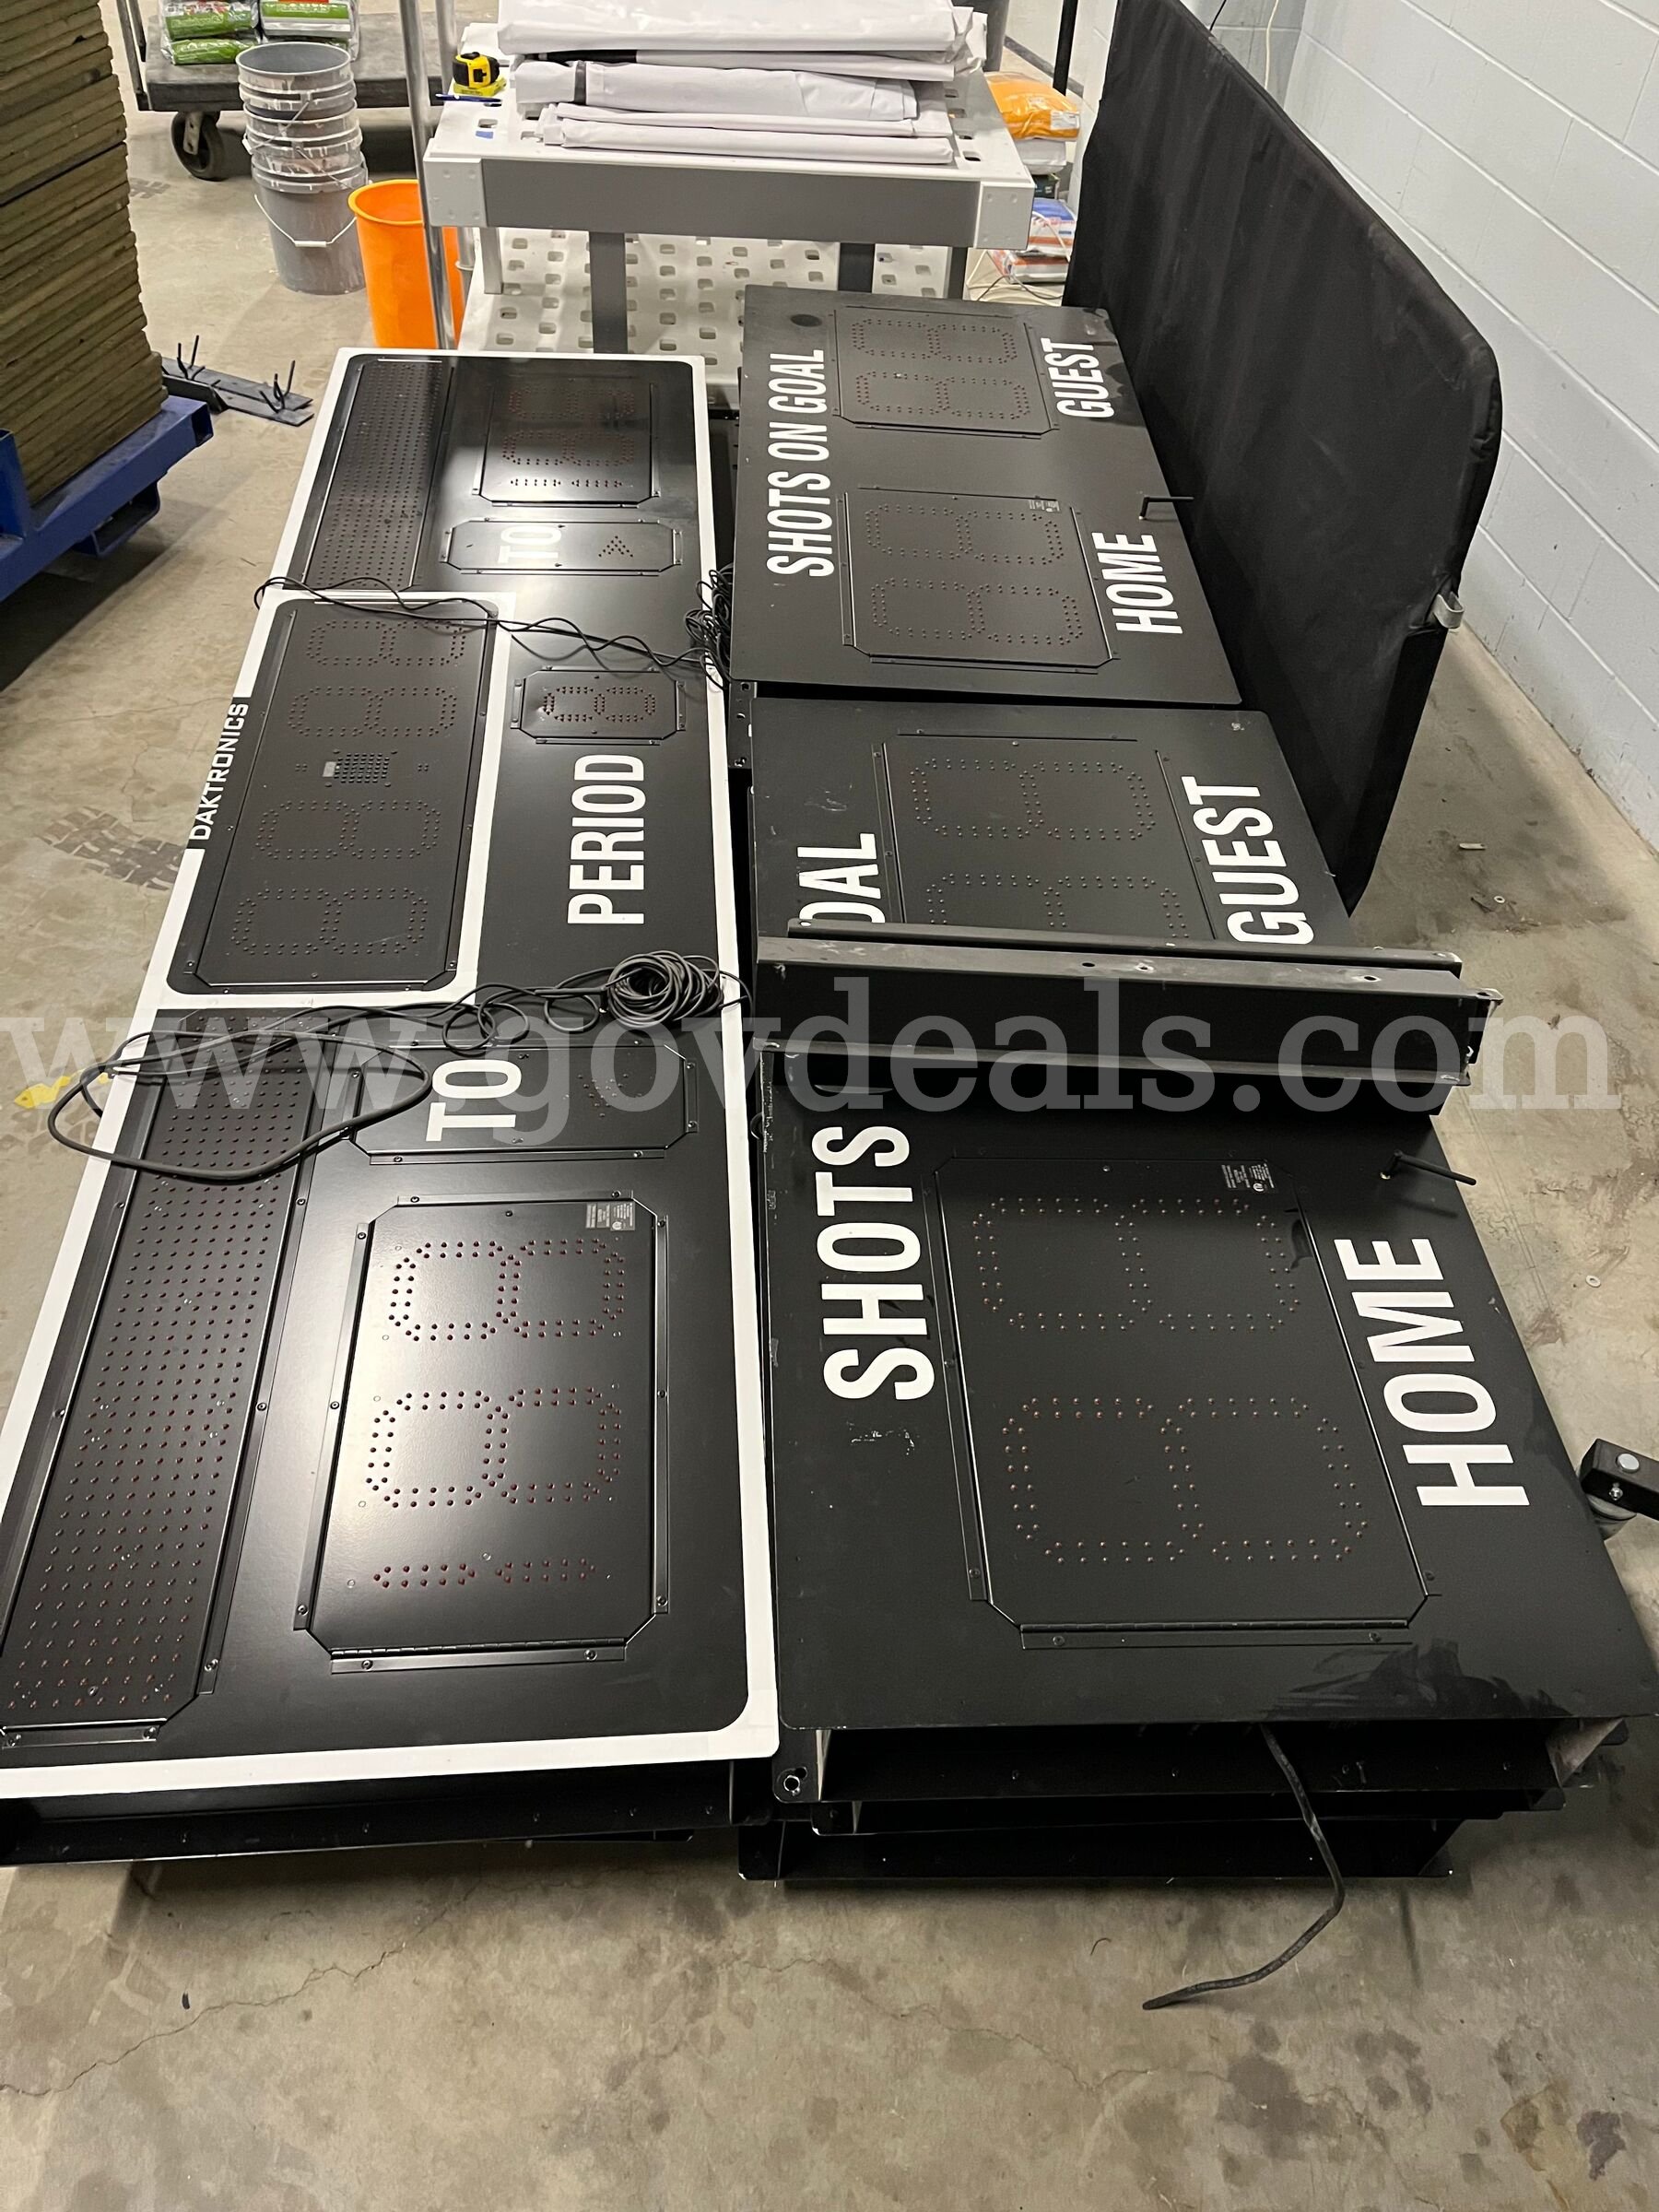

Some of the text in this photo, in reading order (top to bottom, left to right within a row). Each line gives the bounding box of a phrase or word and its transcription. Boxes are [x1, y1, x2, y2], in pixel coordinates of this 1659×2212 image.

[1041, 337, 1115, 418] GUEST
[767, 349, 835, 577] SHOTS ON GOAL
[498, 524, 562, 564] TO
[1091, 532, 1183, 634] HOME
[188, 703, 250, 841] DAKTRONICS
[568, 754, 646, 924] PERIOD
[1181, 776, 1314, 945] GUEST
[425, 1060, 522, 1143] TO
[811, 1126, 935, 1400] SHOTS
[1334, 1238, 1530, 1507] HOME
